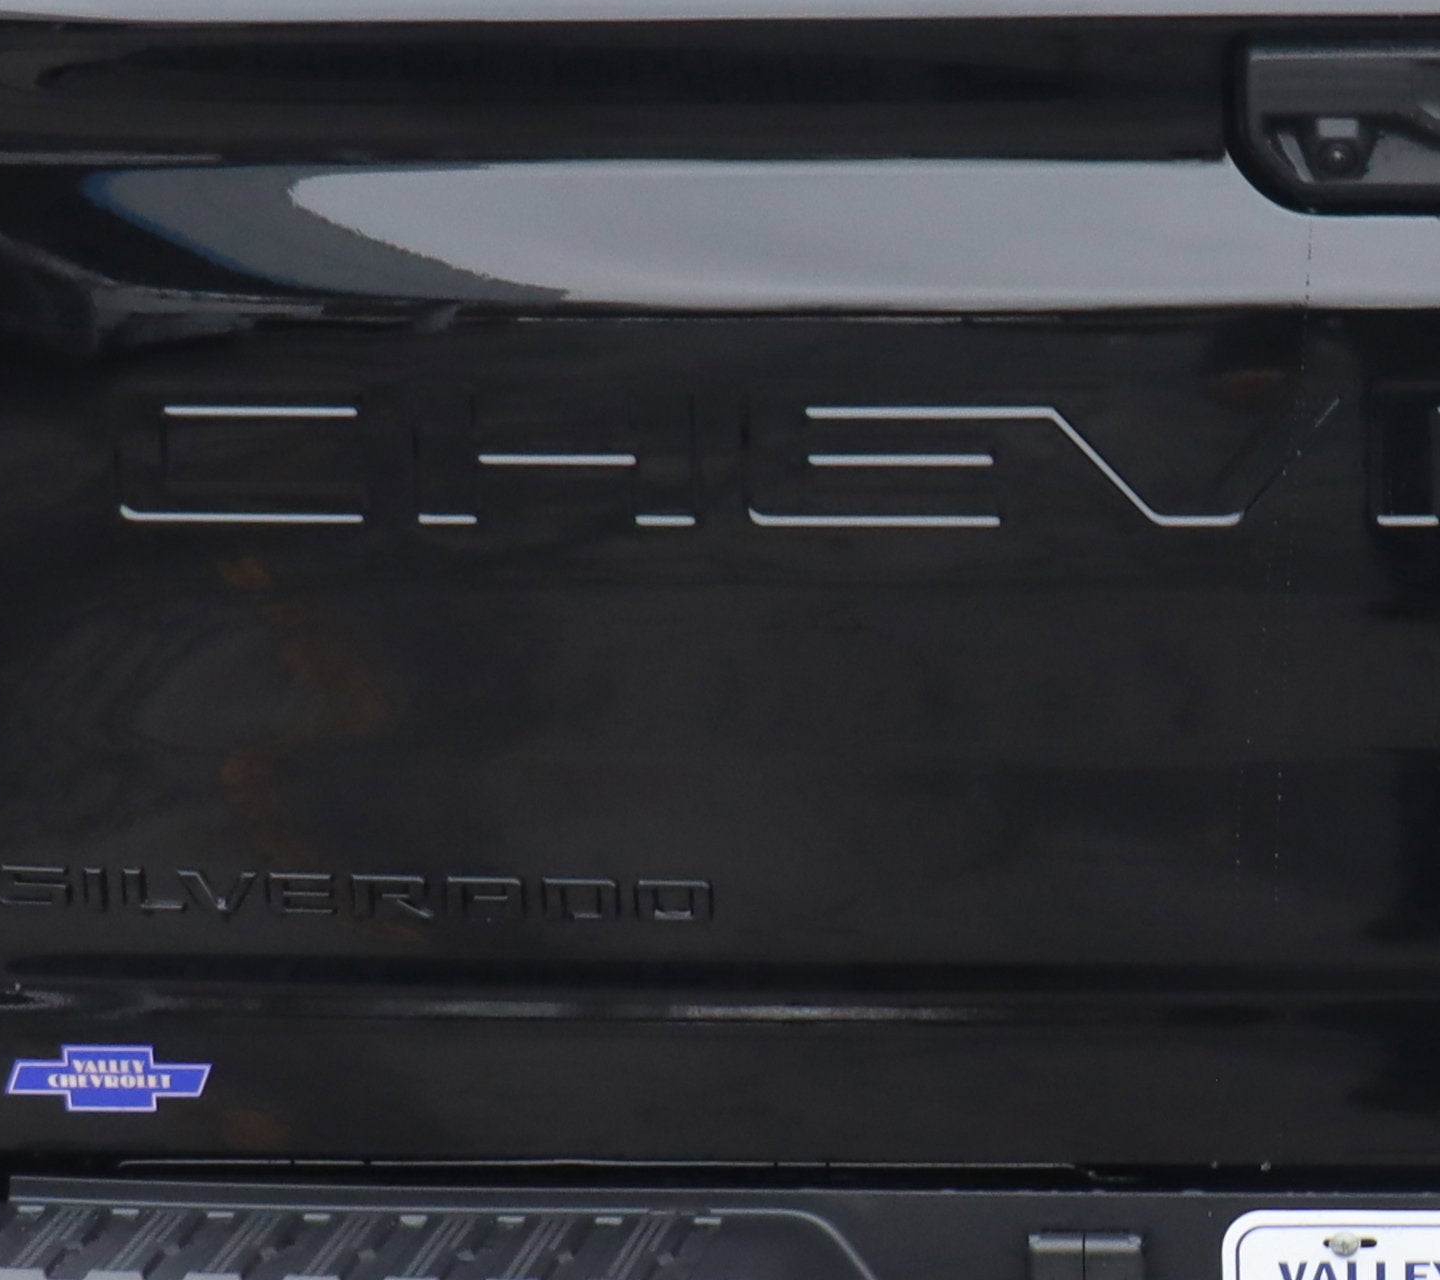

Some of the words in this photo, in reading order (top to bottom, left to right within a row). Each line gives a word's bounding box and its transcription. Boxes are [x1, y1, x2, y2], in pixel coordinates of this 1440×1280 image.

[0, 863, 716, 922] SILVERADO
[72, 1059, 146, 1073] VALLEY
[47, 1074, 171, 1088] CHEVROLET
